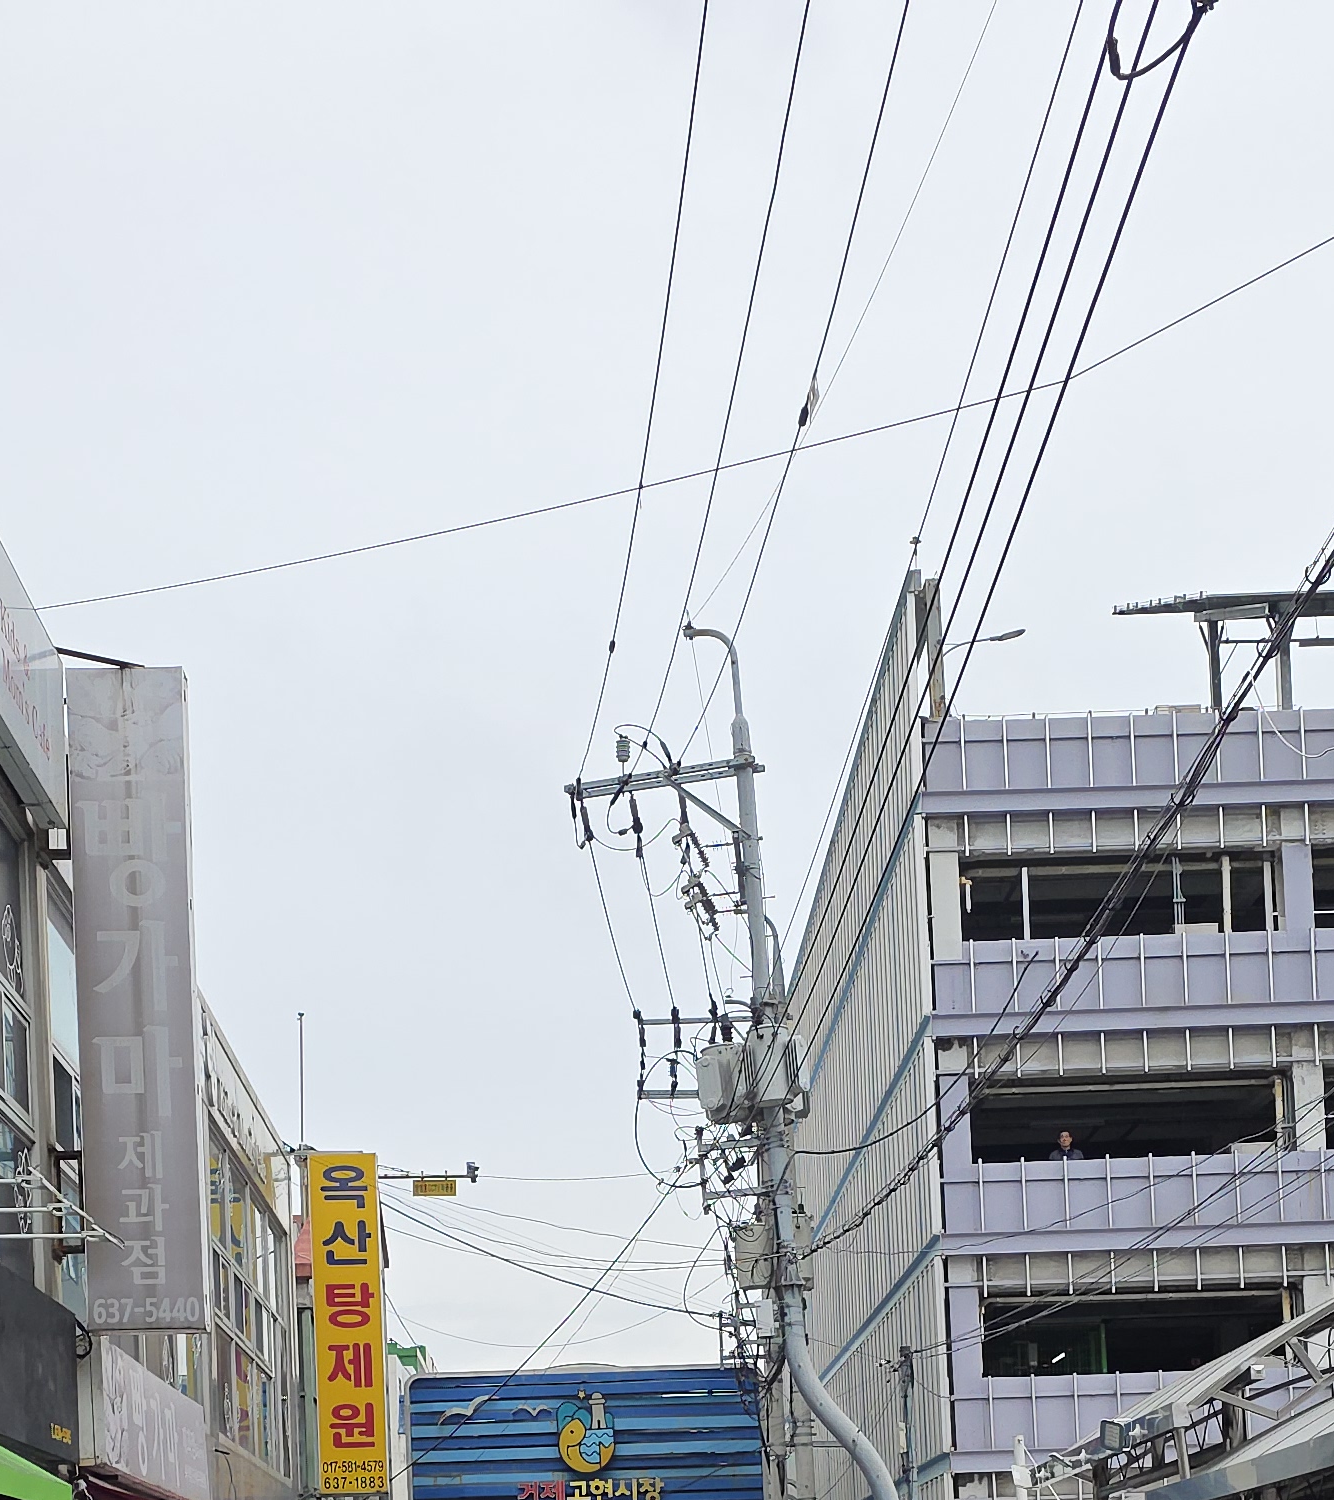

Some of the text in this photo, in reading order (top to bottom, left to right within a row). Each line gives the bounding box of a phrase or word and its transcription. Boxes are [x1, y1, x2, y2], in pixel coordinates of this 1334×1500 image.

[117, 1130, 171, 1286] 제과점
[92, 1297, 201, 1325] 637-5440
[319, 1164, 376, 1450] 옥산탕제원
[323, 1475, 385, 1490] 637-1883
